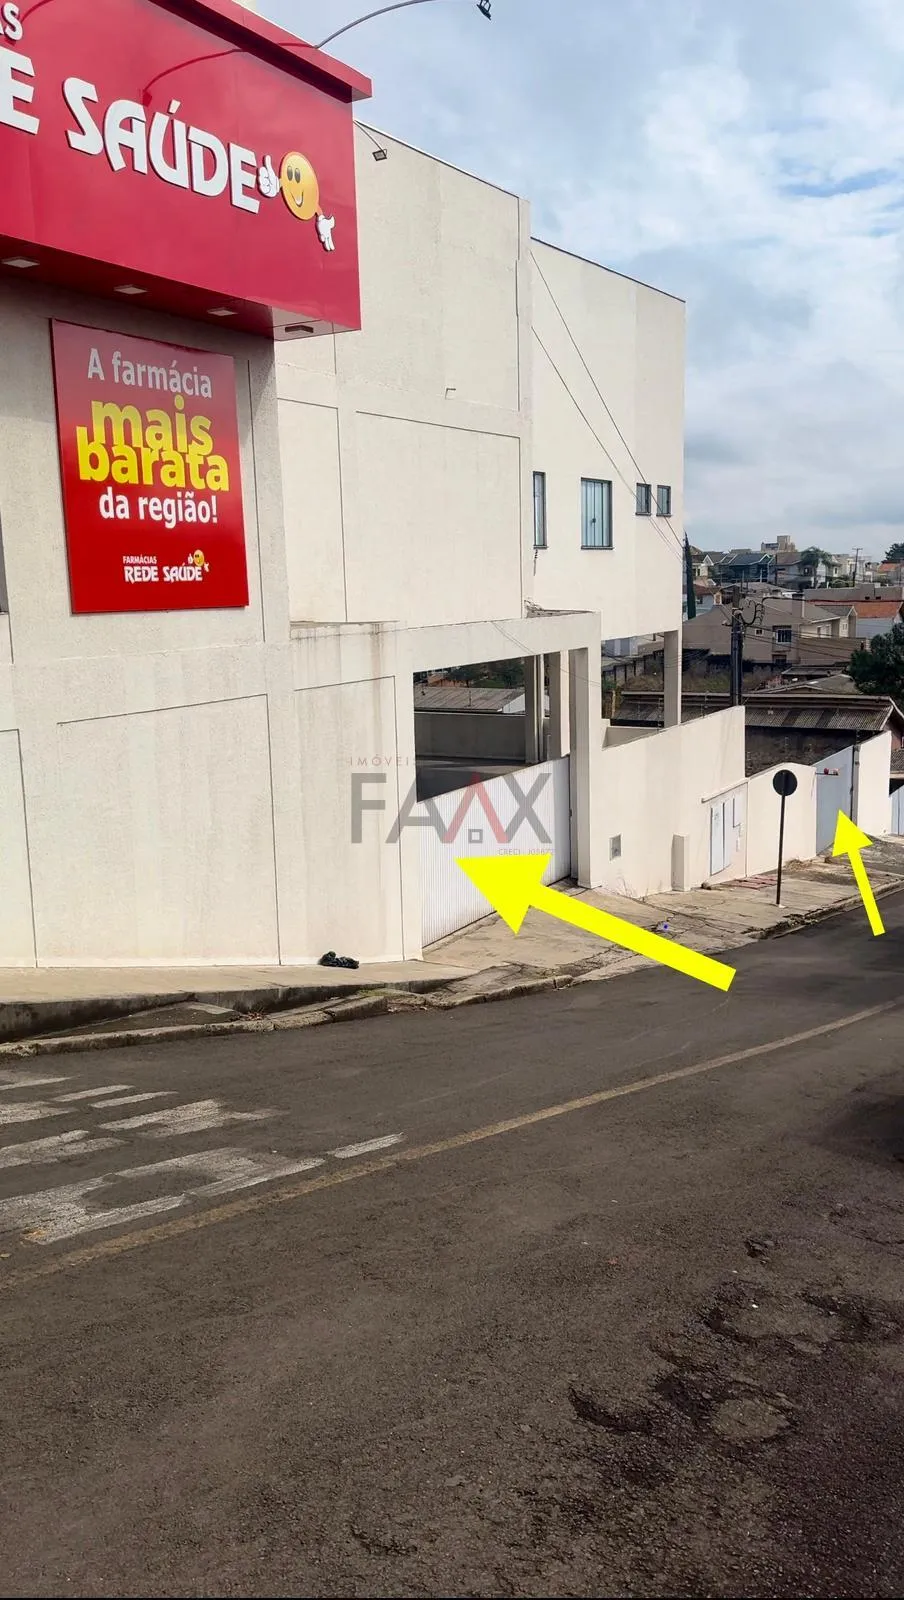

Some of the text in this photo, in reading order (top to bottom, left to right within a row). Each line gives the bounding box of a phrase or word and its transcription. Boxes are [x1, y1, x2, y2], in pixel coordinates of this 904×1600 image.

[0, 2, 23, 41] S
[62, 77, 260, 214] SAÚDE
[87, 348, 213, 398] A farmácia
[91, 394, 214, 456] mais
[76, 426, 230, 492] barata
[99, 486, 218, 529] da região!
[122, 554, 158, 565] FARMÁCIAS
[123, 562, 203, 584] REDE SAÚDE
